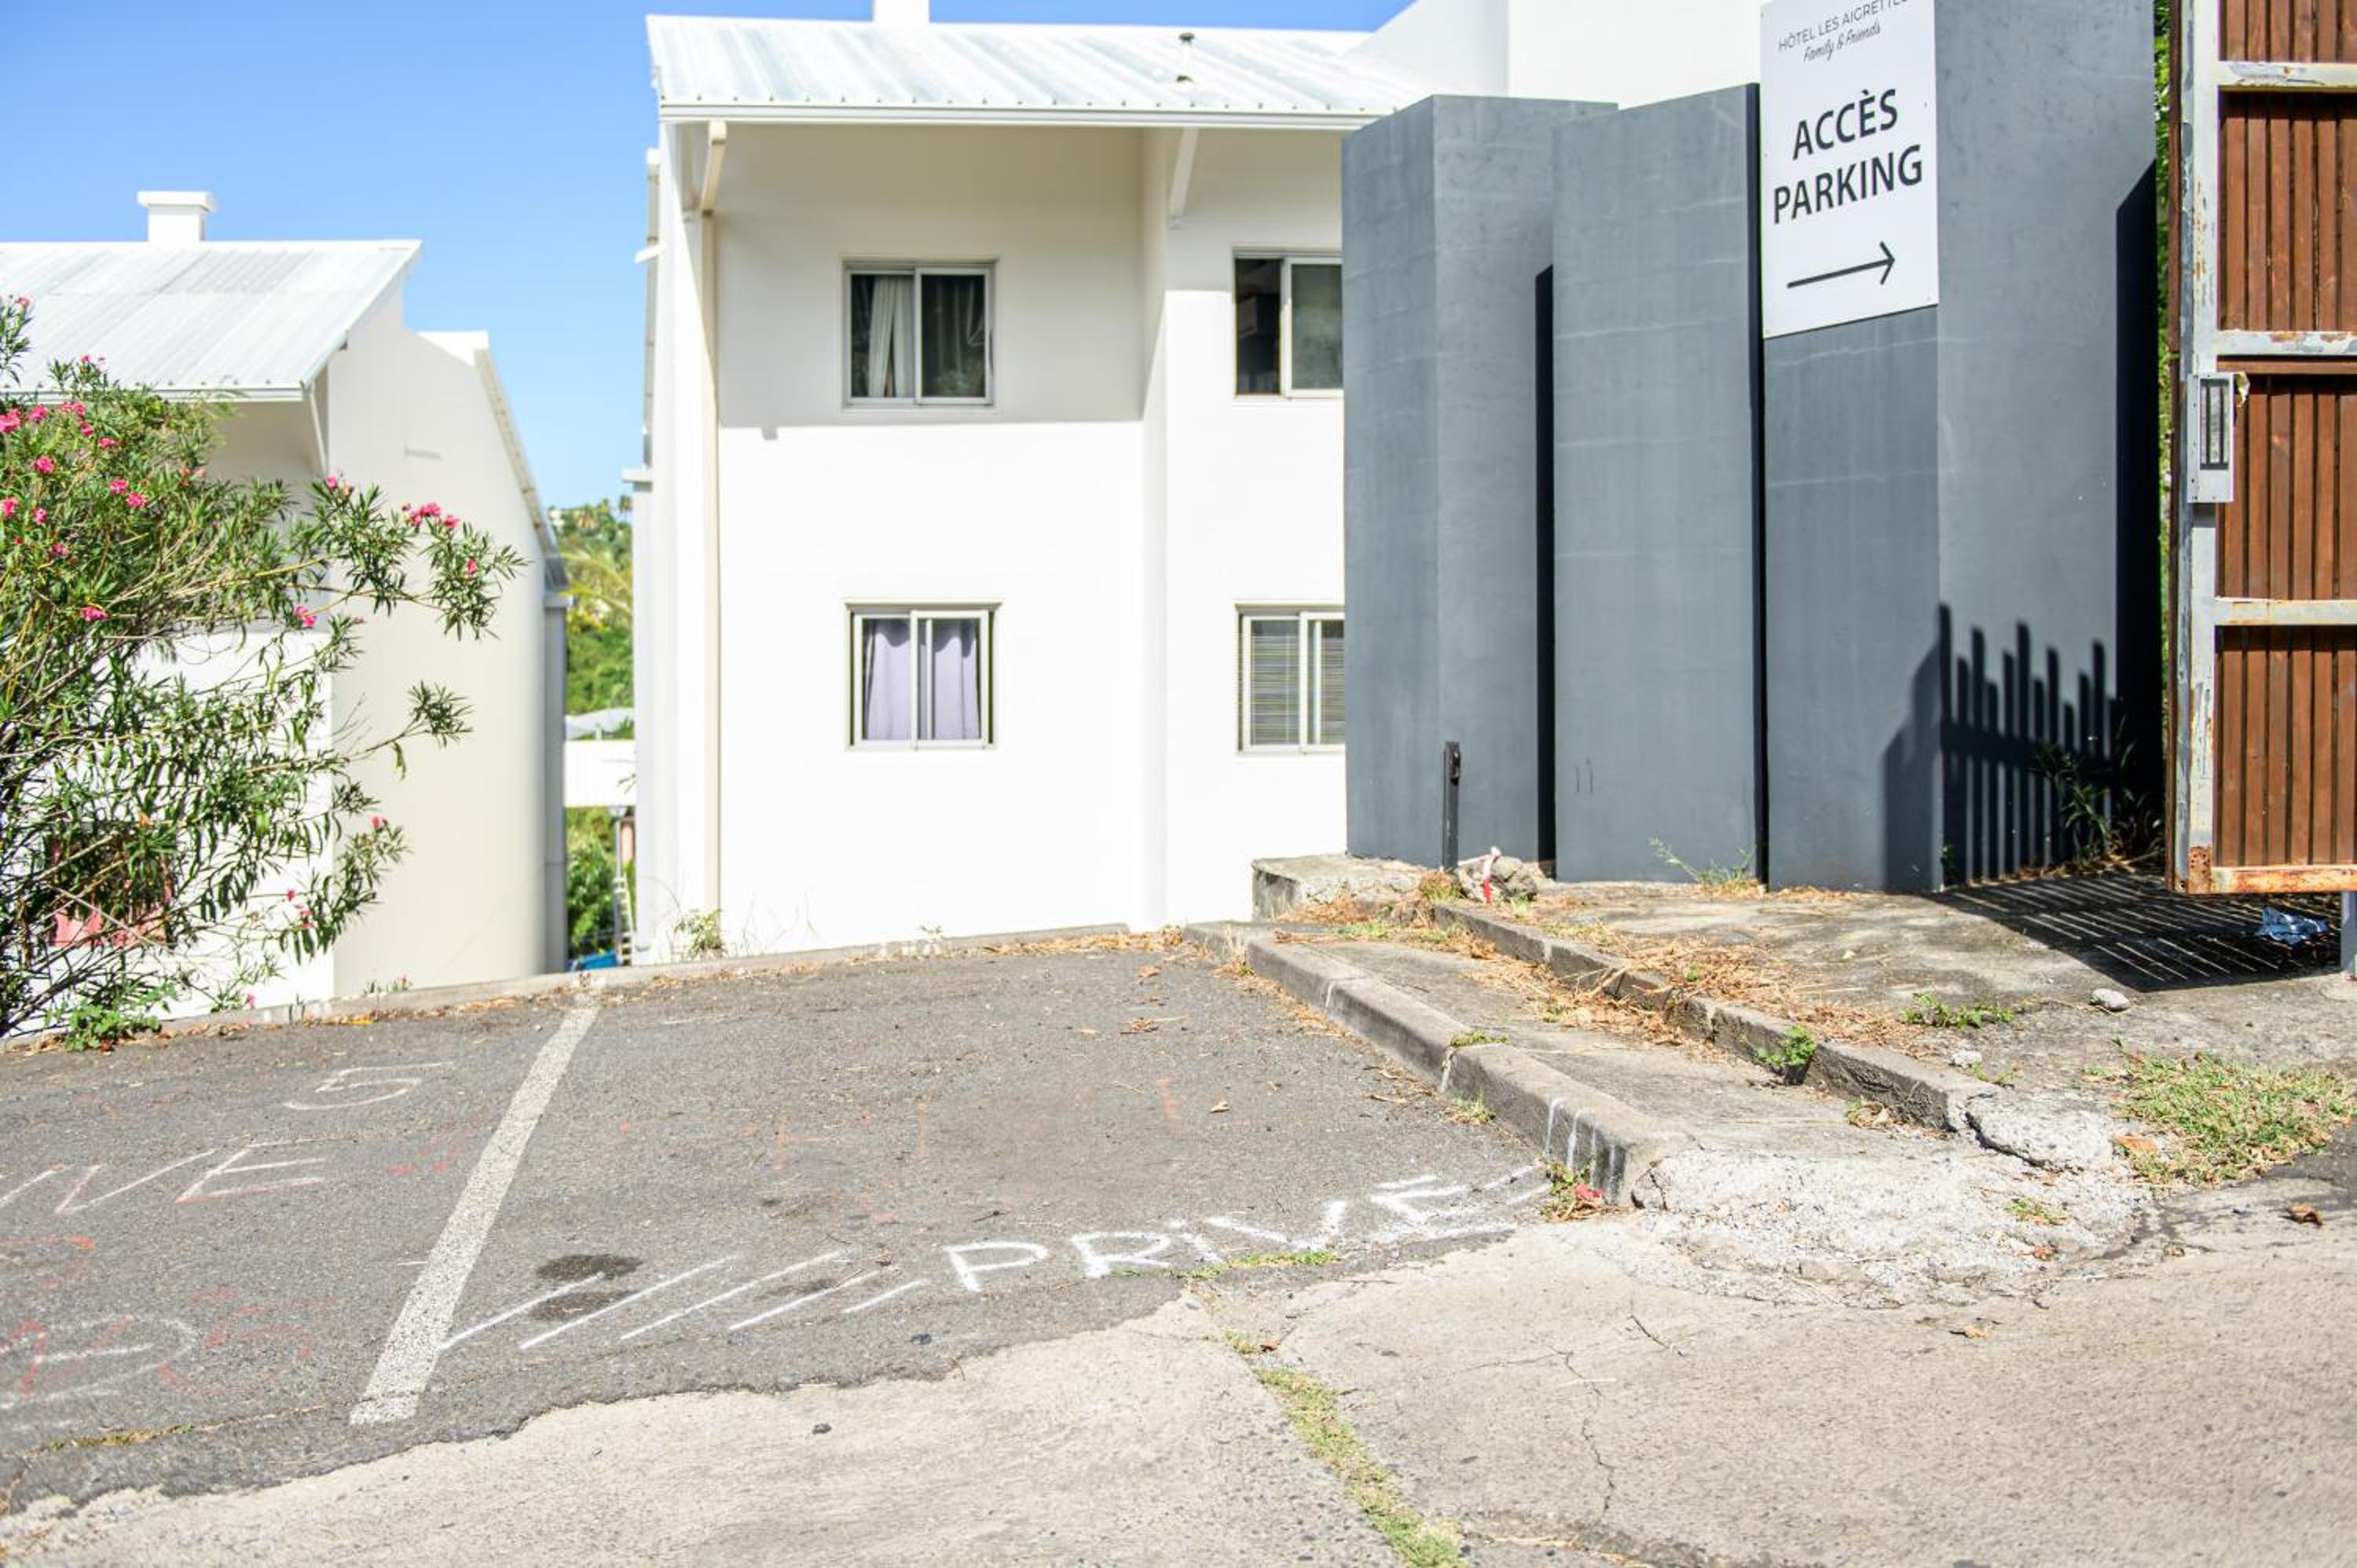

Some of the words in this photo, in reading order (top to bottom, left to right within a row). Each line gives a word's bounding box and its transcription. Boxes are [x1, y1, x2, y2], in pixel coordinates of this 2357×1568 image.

[1778, 27, 1815, 51] HÔTEL
[1818, 16, 1840, 36] LES
[1842, 0, 1908, 25] AIGRETT
[1802, 39, 1835, 62] Family
[1845, 20, 1881, 46] Friends
[1792, 88, 1898, 161] ACCÈS
[1773, 144, 1923, 225] PARKING
